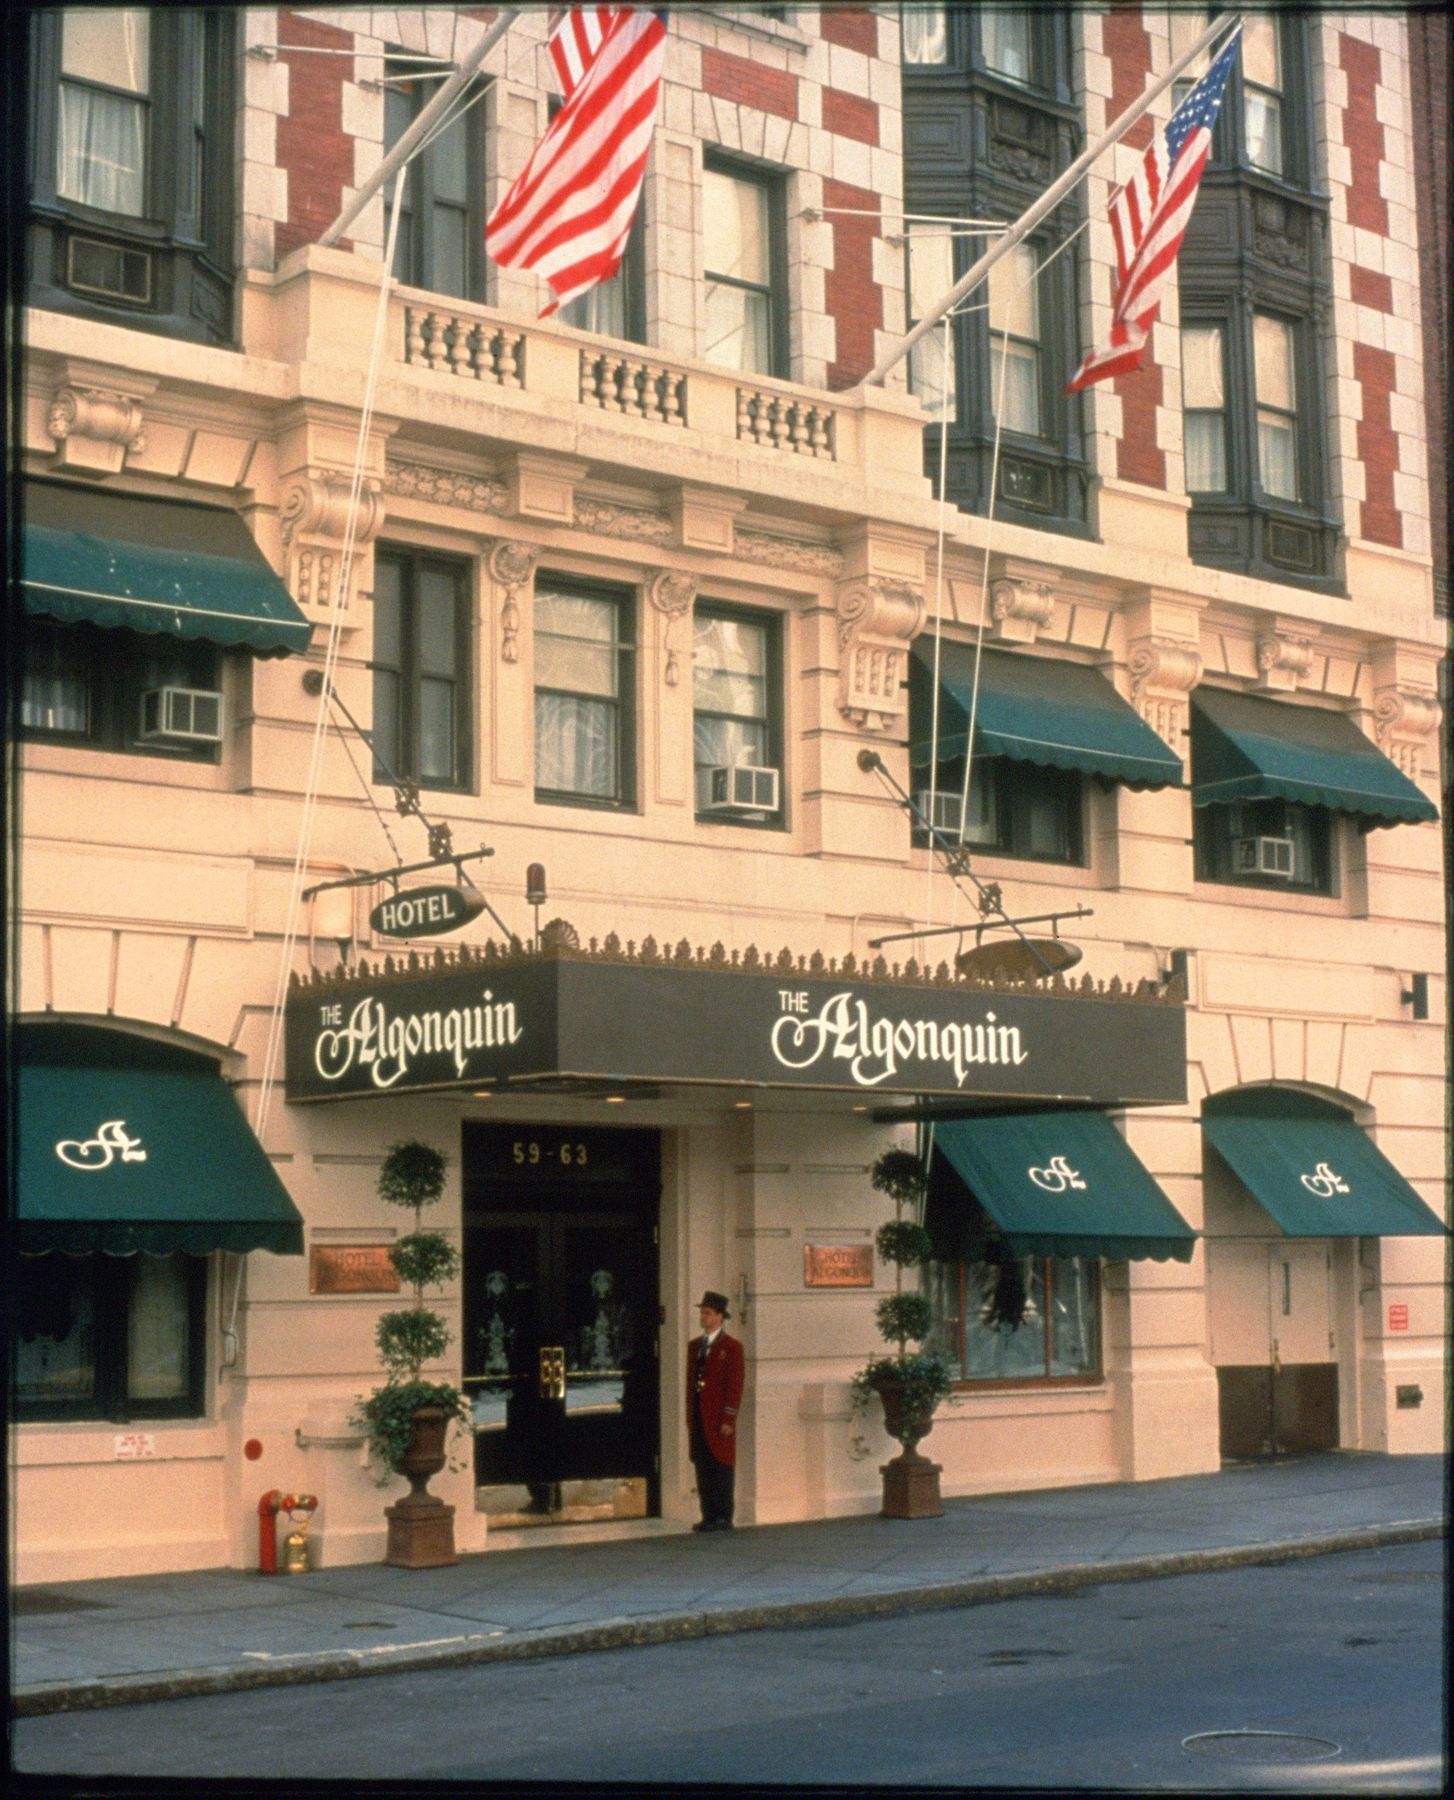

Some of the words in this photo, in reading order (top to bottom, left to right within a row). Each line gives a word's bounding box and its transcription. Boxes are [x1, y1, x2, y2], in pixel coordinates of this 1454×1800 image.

[382, 893, 456, 931] HOTEL
[778, 990, 809, 1013] THE
[320, 1004, 342, 1026] THE
[315, 989, 523, 1088] Algonquin
[771, 992, 1028, 1087] Algonquin
[513, 1142, 587, 1165] 59-63
[824, 1251, 863, 1265] HOTE
